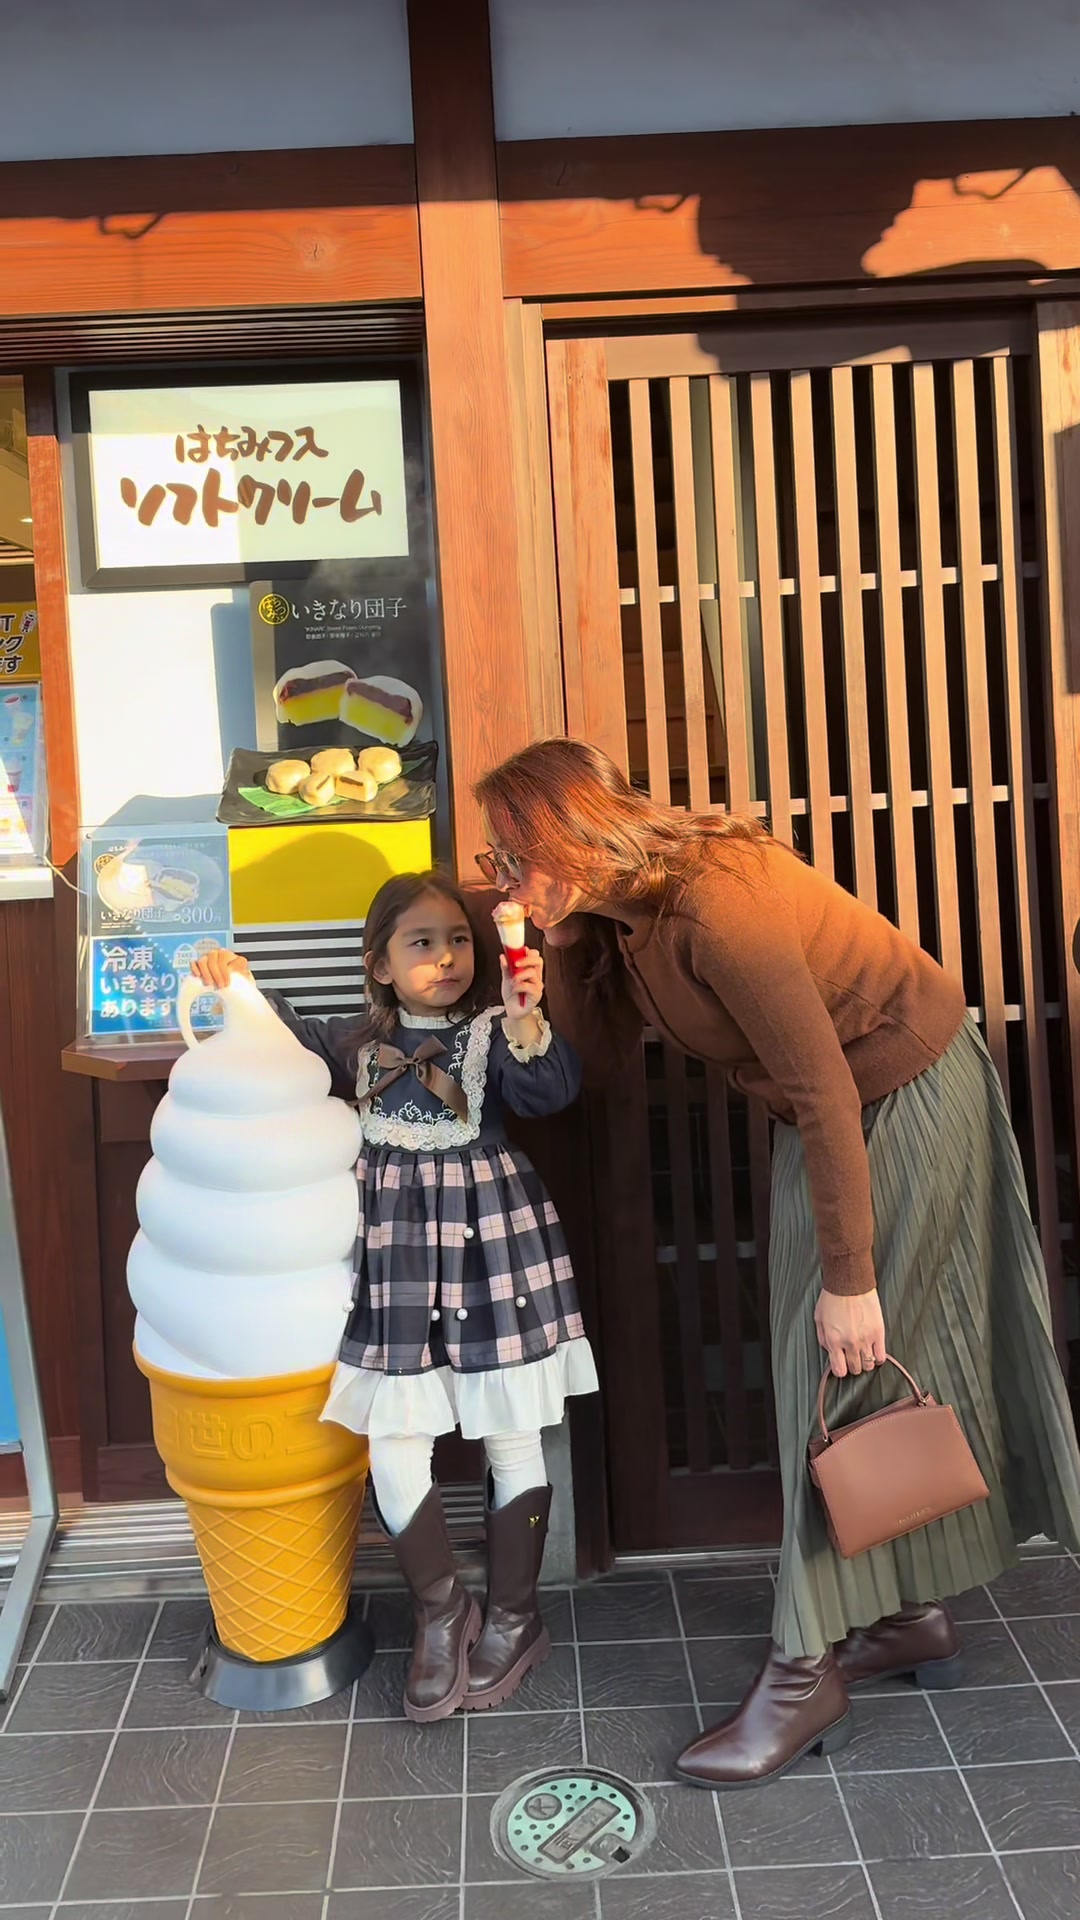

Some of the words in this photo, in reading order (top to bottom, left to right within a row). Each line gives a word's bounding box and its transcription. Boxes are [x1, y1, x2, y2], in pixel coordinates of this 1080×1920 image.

[175, 423, 329, 464] はちみつ入
[119, 467, 382, 528] ソフトクリーム
[291, 597, 407, 621] いきなり団子
[101, 945, 154, 973] 冷凍
[101, 972, 186, 995] いきなり
[101, 995, 177, 1019] あります
